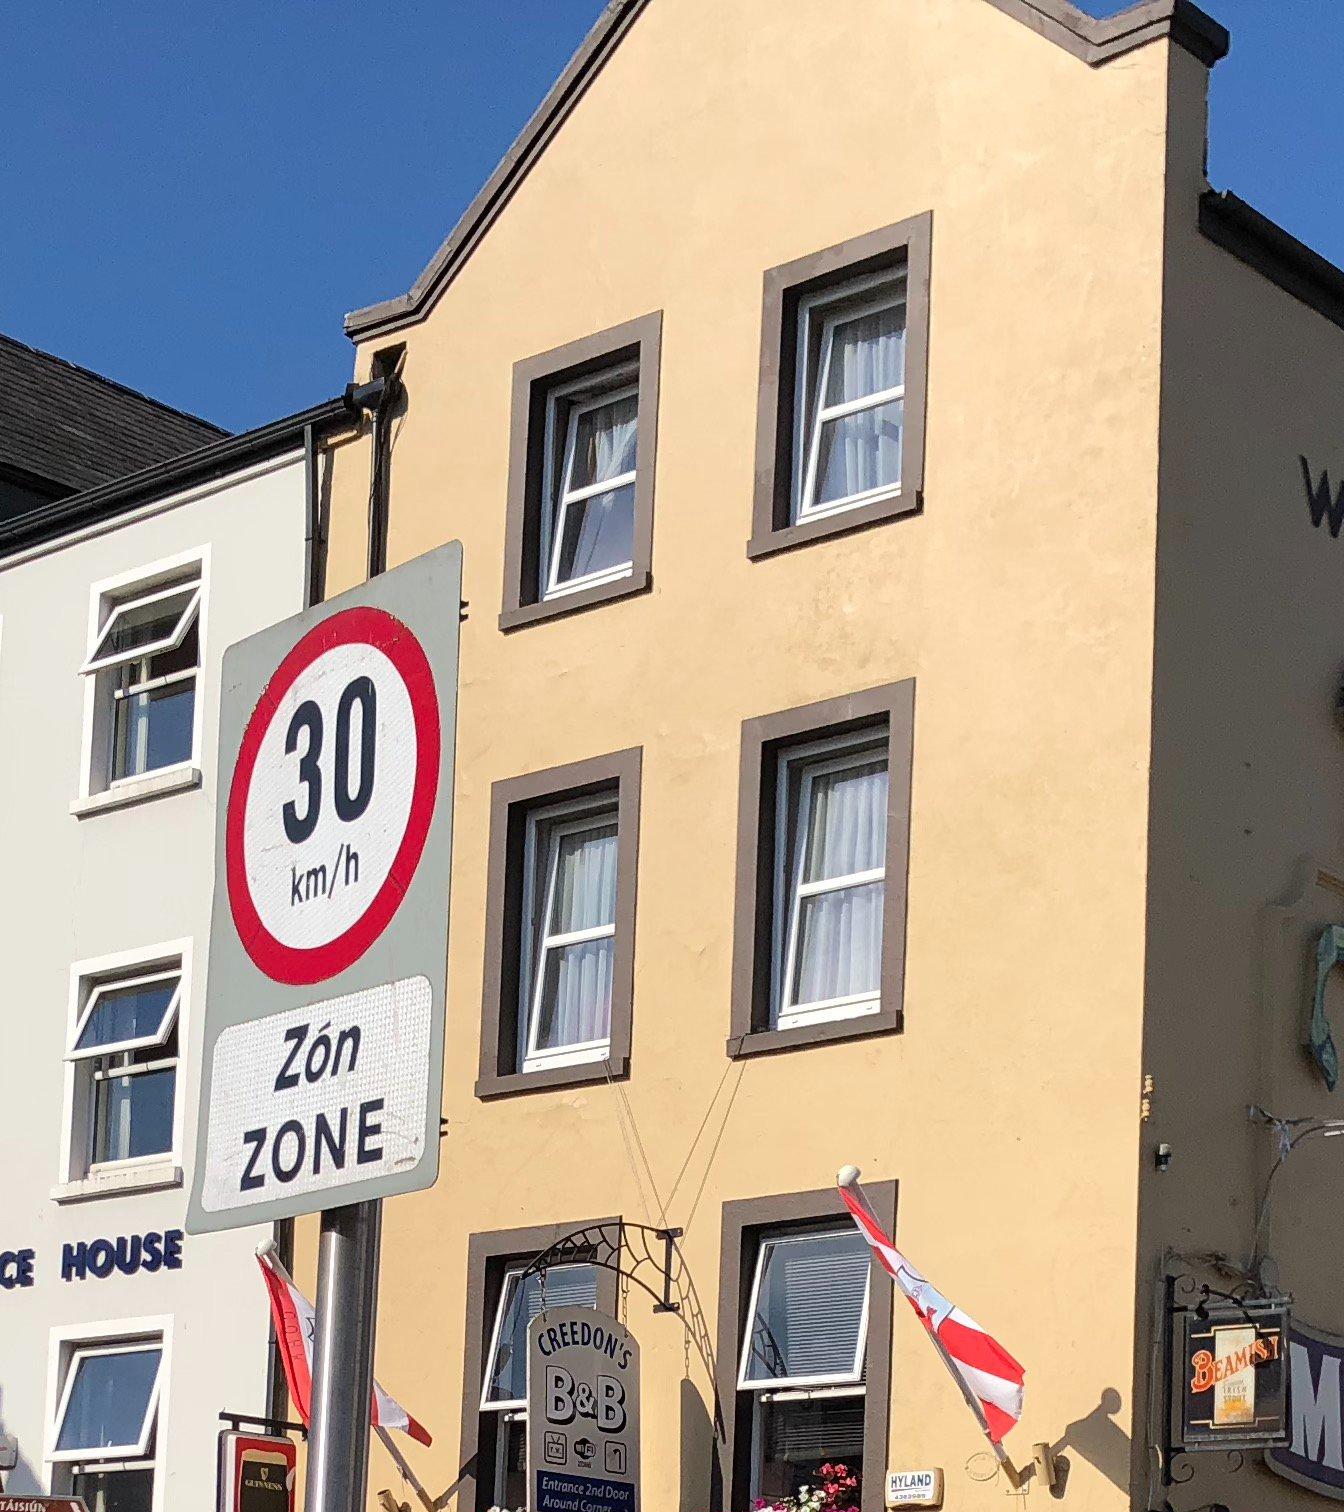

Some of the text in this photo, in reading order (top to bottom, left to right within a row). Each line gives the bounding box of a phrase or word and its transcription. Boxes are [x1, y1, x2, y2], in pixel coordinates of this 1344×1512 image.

[282, 675, 377, 844] 30
[290, 843, 359, 907] km/h
[274, 1019, 361, 1092] Zón
[240, 1098, 384, 1193] ZONE
[61, 1229, 184, 1282] HOUSE
[538, 1321, 632, 1370] CREEDON'S
[544, 1365, 627, 1434] B&B
[244, 1480, 283, 1491] GUINNESS
[542, 1477, 629, 1500] Entrance 2nd Door
[543, 1495, 578, 1512] Around
[891, 1474, 932, 1488] HYLAND
